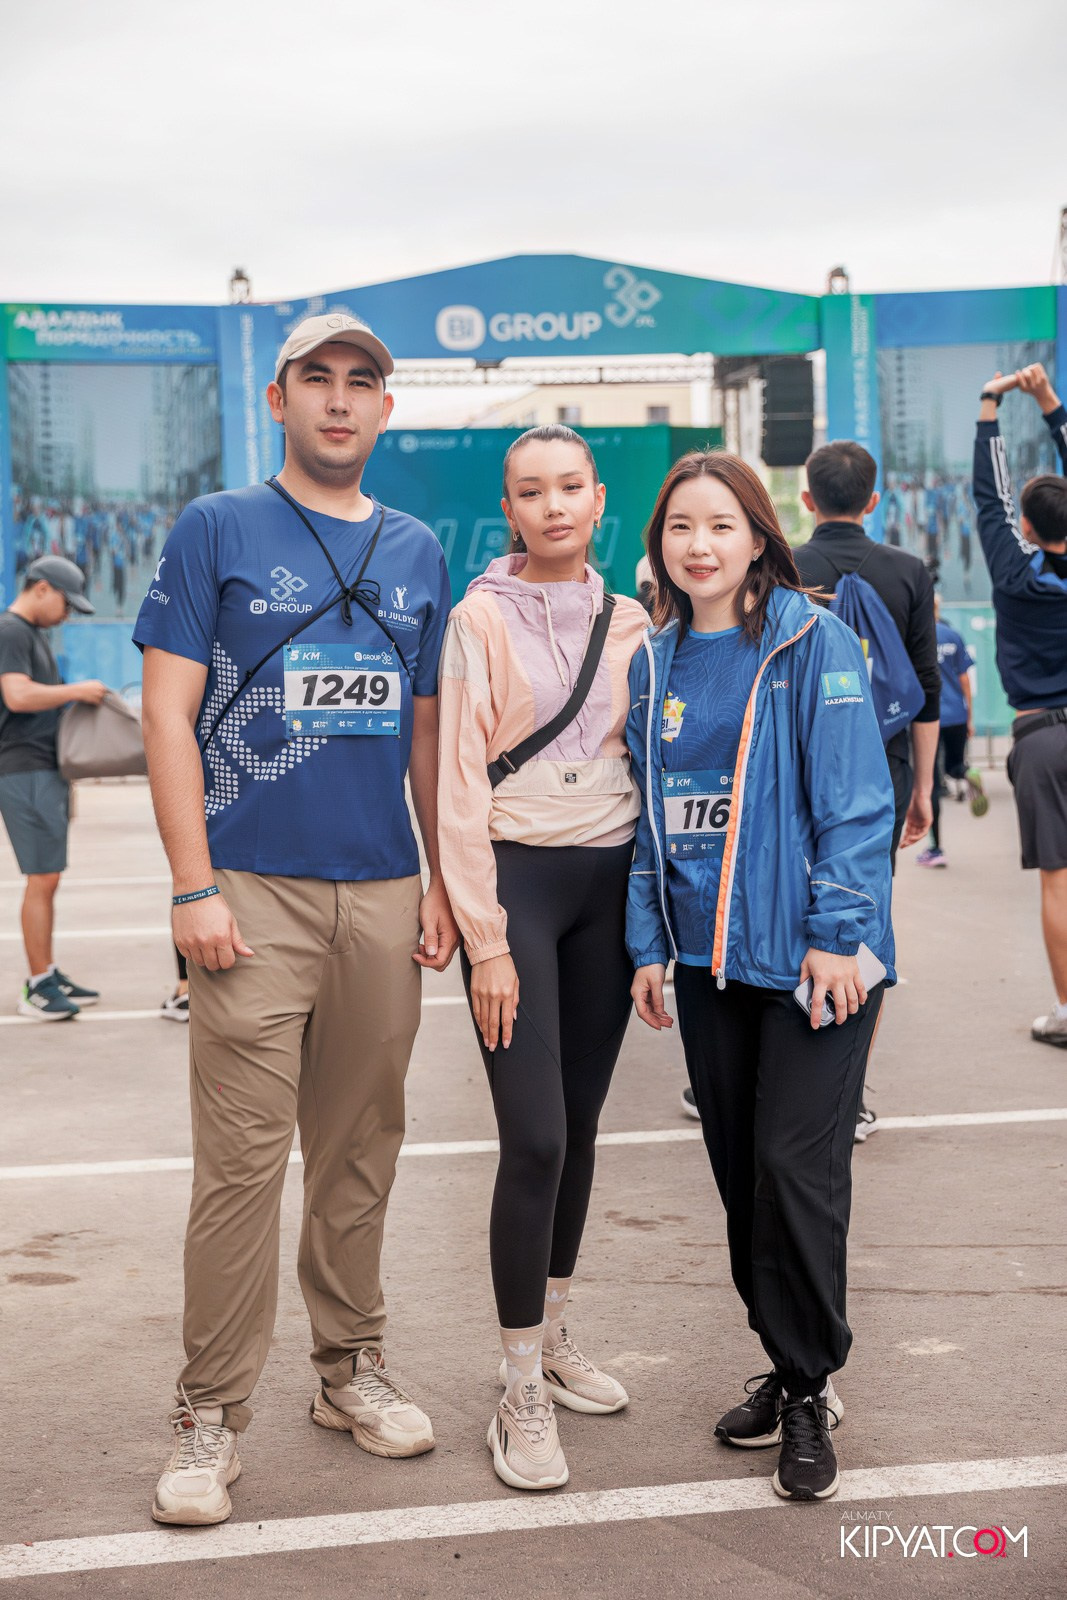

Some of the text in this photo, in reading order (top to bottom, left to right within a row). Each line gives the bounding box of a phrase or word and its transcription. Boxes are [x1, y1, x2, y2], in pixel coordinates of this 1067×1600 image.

[489, 312, 602, 342] GROUP
[271, 566, 308, 601] 30
[150, 589, 170, 605] City
[270, 602, 313, 613] GROUP
[377, 609, 387, 618] BI
[290, 650, 320, 661] 5 KM
[363, 653, 381, 661] GROUP
[302, 674, 390, 706] 1249
[825, 697, 864, 705] KAZAKHSTAN
[666, 777, 674, 787] 5
[676, 778, 691, 787] KM
